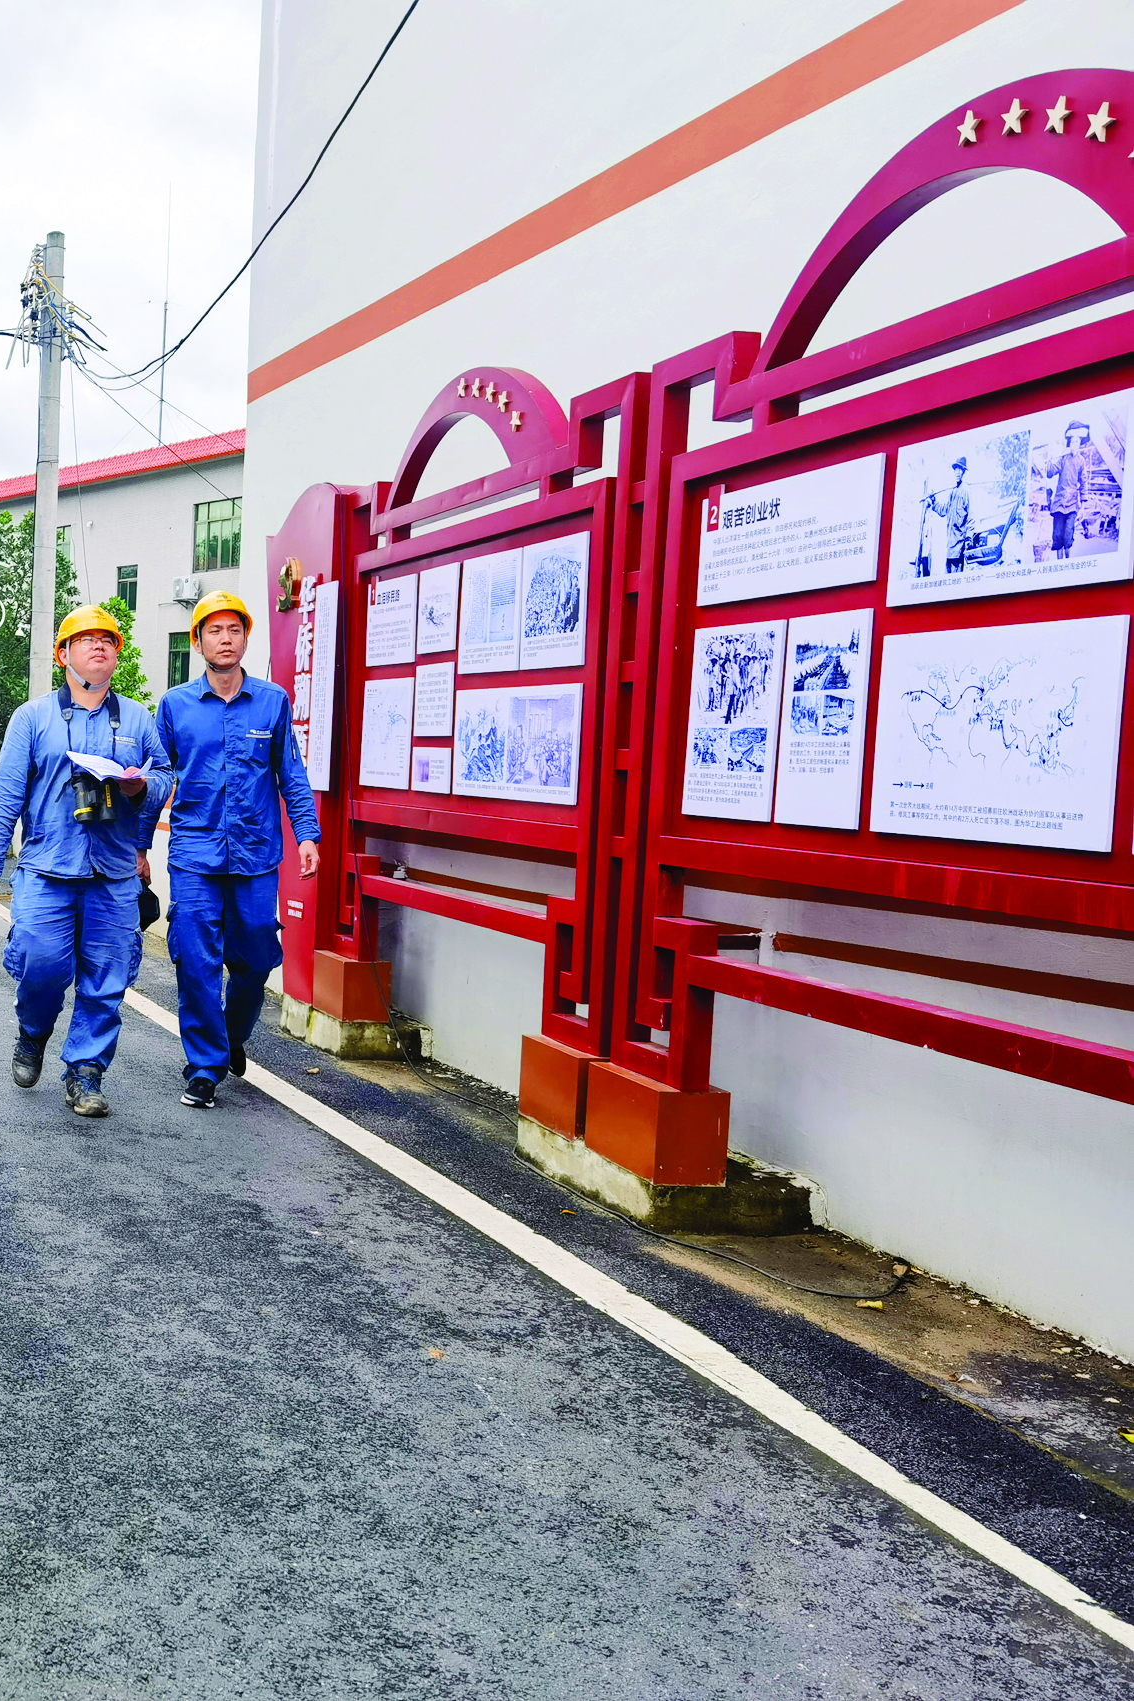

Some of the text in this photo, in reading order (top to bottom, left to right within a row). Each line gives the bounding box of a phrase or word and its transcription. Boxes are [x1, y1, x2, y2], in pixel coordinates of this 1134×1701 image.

[709, 505, 719, 525] 2
[722, 497, 781, 530] 艰苦创业状
